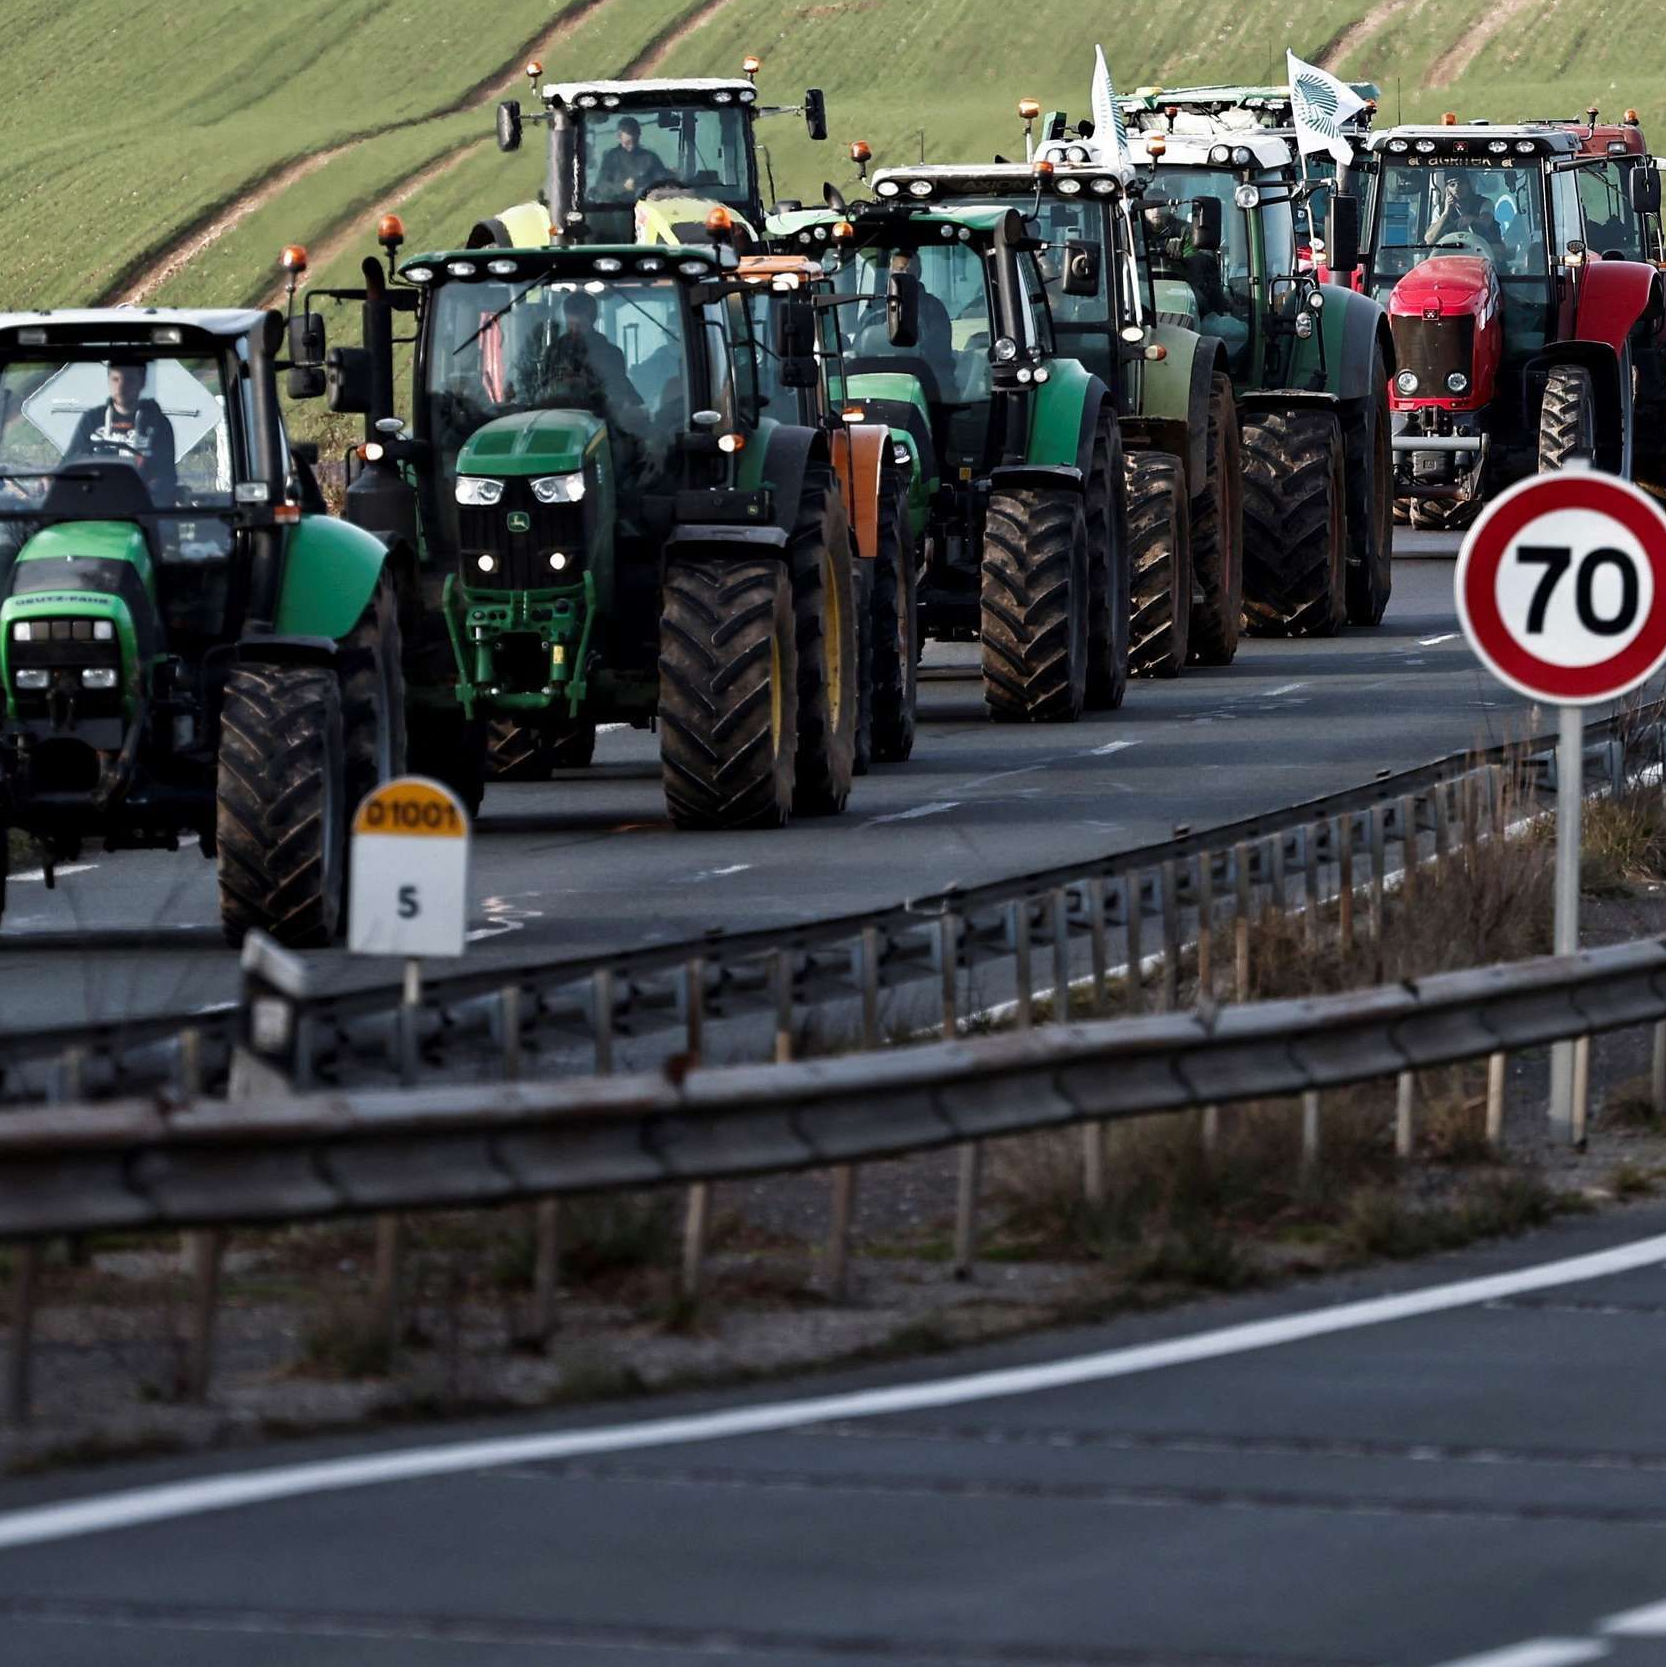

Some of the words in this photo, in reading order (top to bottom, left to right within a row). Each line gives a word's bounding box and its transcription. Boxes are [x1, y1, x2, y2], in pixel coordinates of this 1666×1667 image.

[962, 180, 1031, 189] AXION
[1516, 545, 1640, 637] 70
[397, 884, 421, 920] 5
